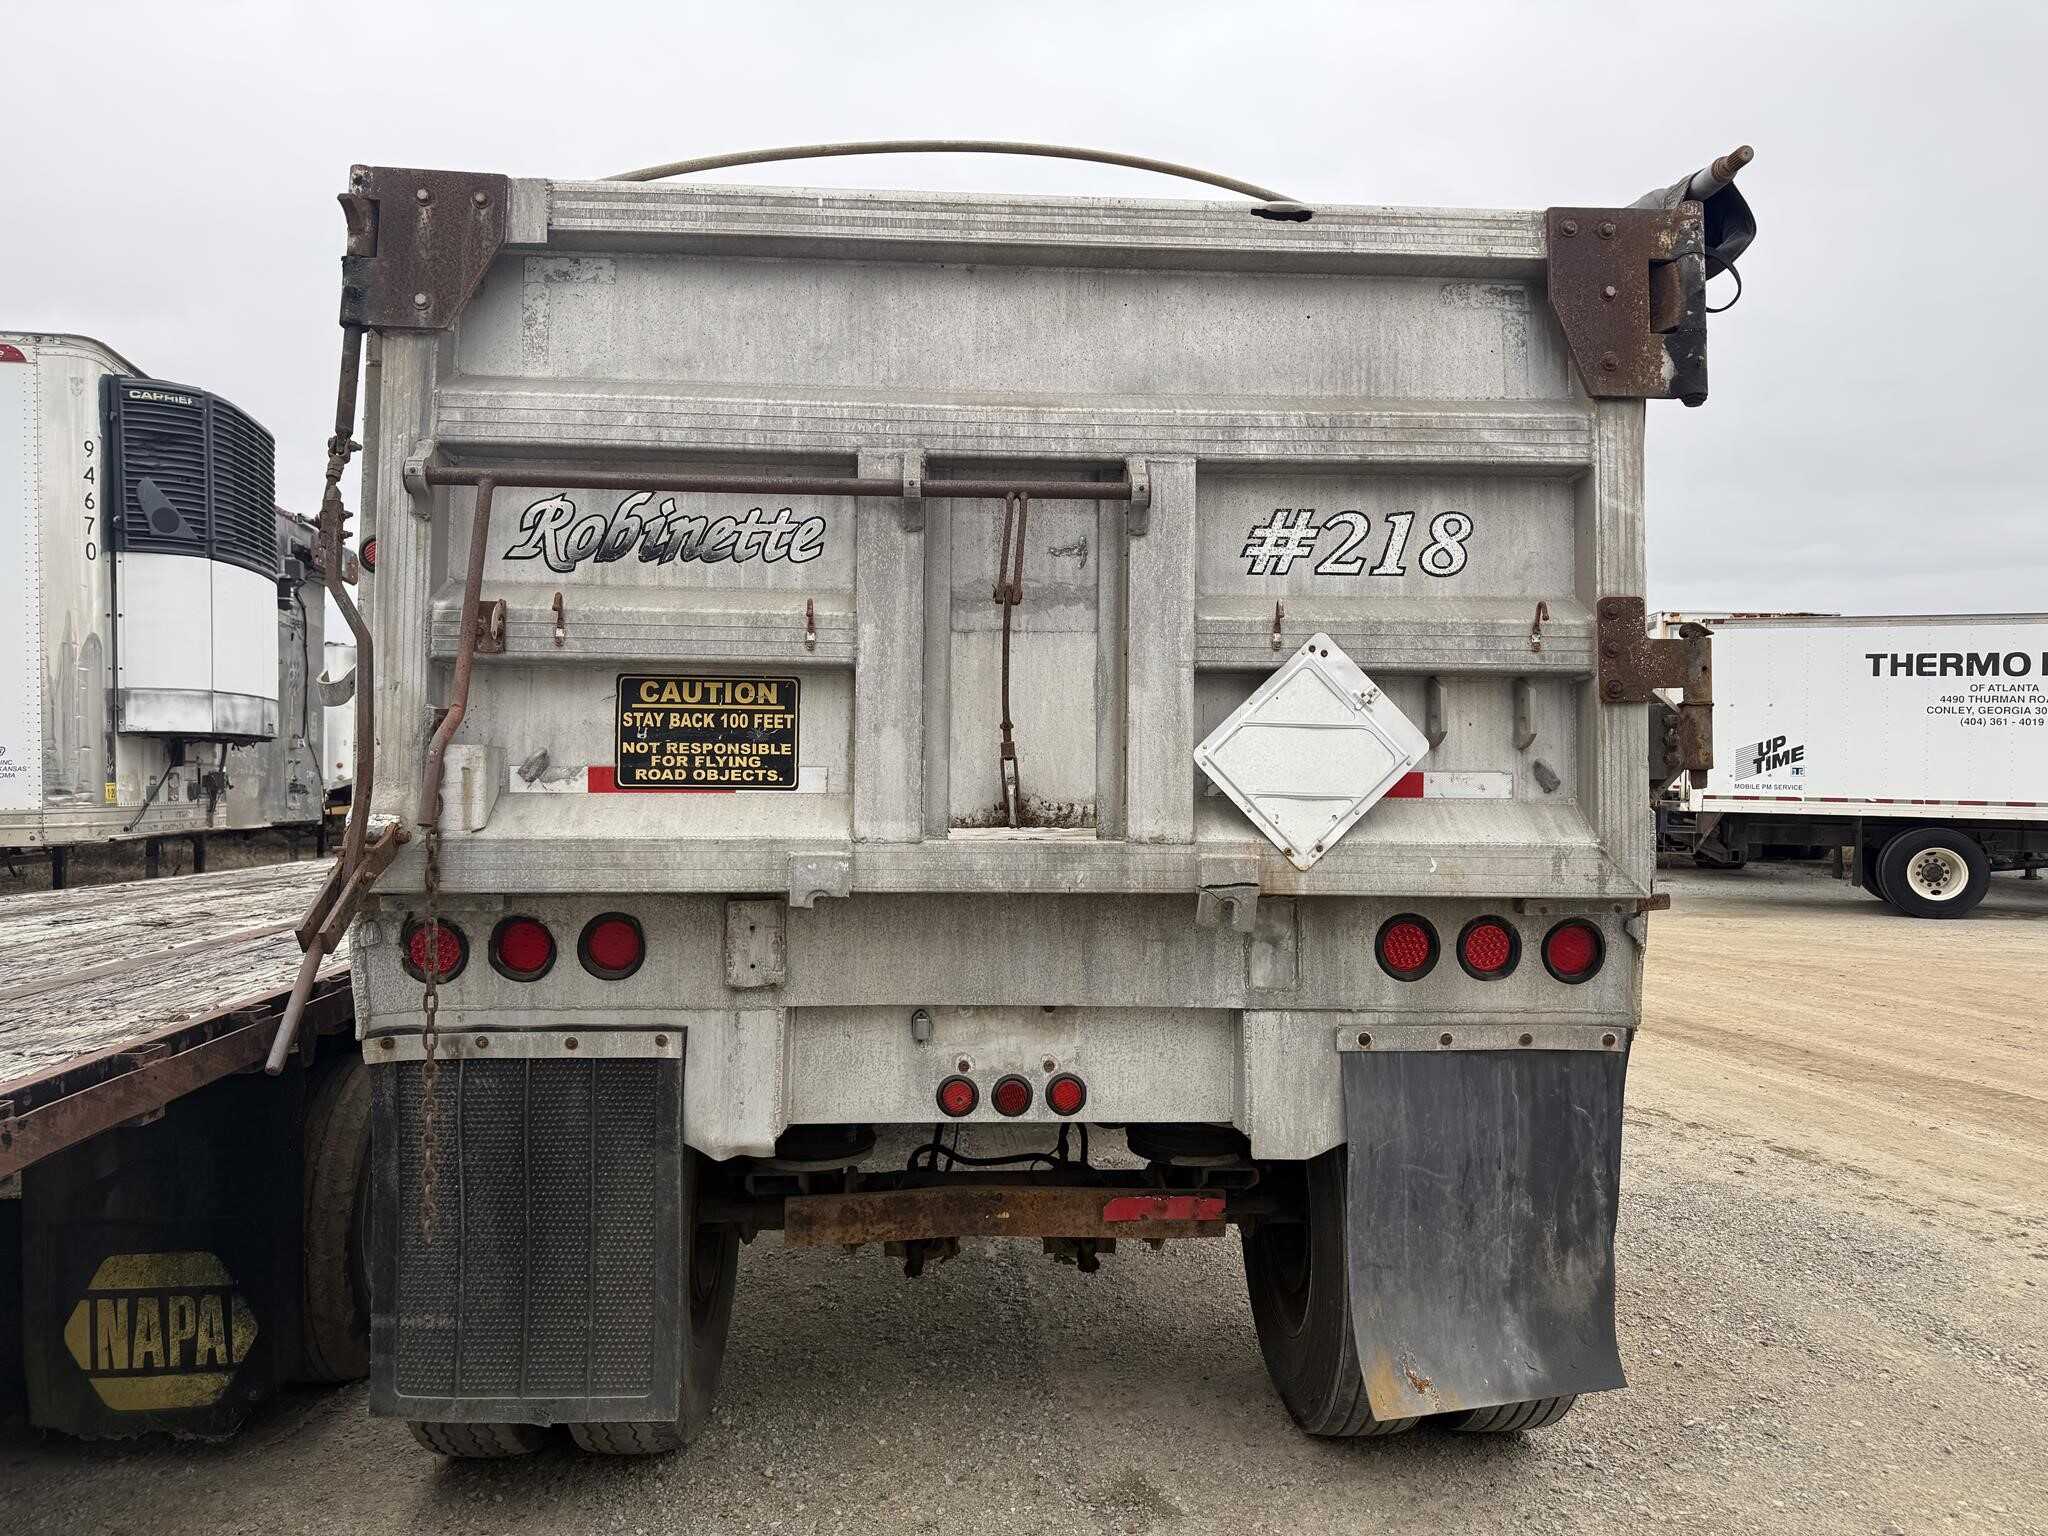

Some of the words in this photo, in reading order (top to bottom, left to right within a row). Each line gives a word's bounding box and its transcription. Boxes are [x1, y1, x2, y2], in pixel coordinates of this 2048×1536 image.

[83, 440, 97, 561] 94670
[502, 490, 826, 573] Robinette
[1240, 508, 1474, 578] #218
[1865, 651, 2032, 677] THERMO
[639, 680, 778, 705] CAUTION
[1969, 683, 1985, 692] OF
[1987, 683, 2040, 692] ATLANTA
[1939, 695, 1965, 704] 4490
[1968, 695, 2026, 704] THURMAN
[622, 711, 665, 728] STAY
[669, 712, 716, 729] BACK
[720, 712, 749, 729] 100
[753, 713, 795, 729] FEET
[1926, 706, 1975, 716] CONLEY,
[1978, 706, 2032, 715] GEORGIA
[1960, 717, 1987, 727] (404)
[1990, 718, 2008, 726] 361
[2018, 718, 2045, 727] 4019
[622, 741, 660, 754] NOT
[666, 742, 792, 756] RESPONSIBLE
[1757, 735, 1786, 757] UP
[651, 755, 689, 768] FOR
[694, 756, 762, 768] FLYING
[1753, 745, 1804, 775] TIME
[635, 768, 687, 781] ROAD
[693, 769, 784, 782] OBJECTS.
[1773, 783, 1803, 791] SERVICE
[96, 1294, 228, 1370] NAPA
